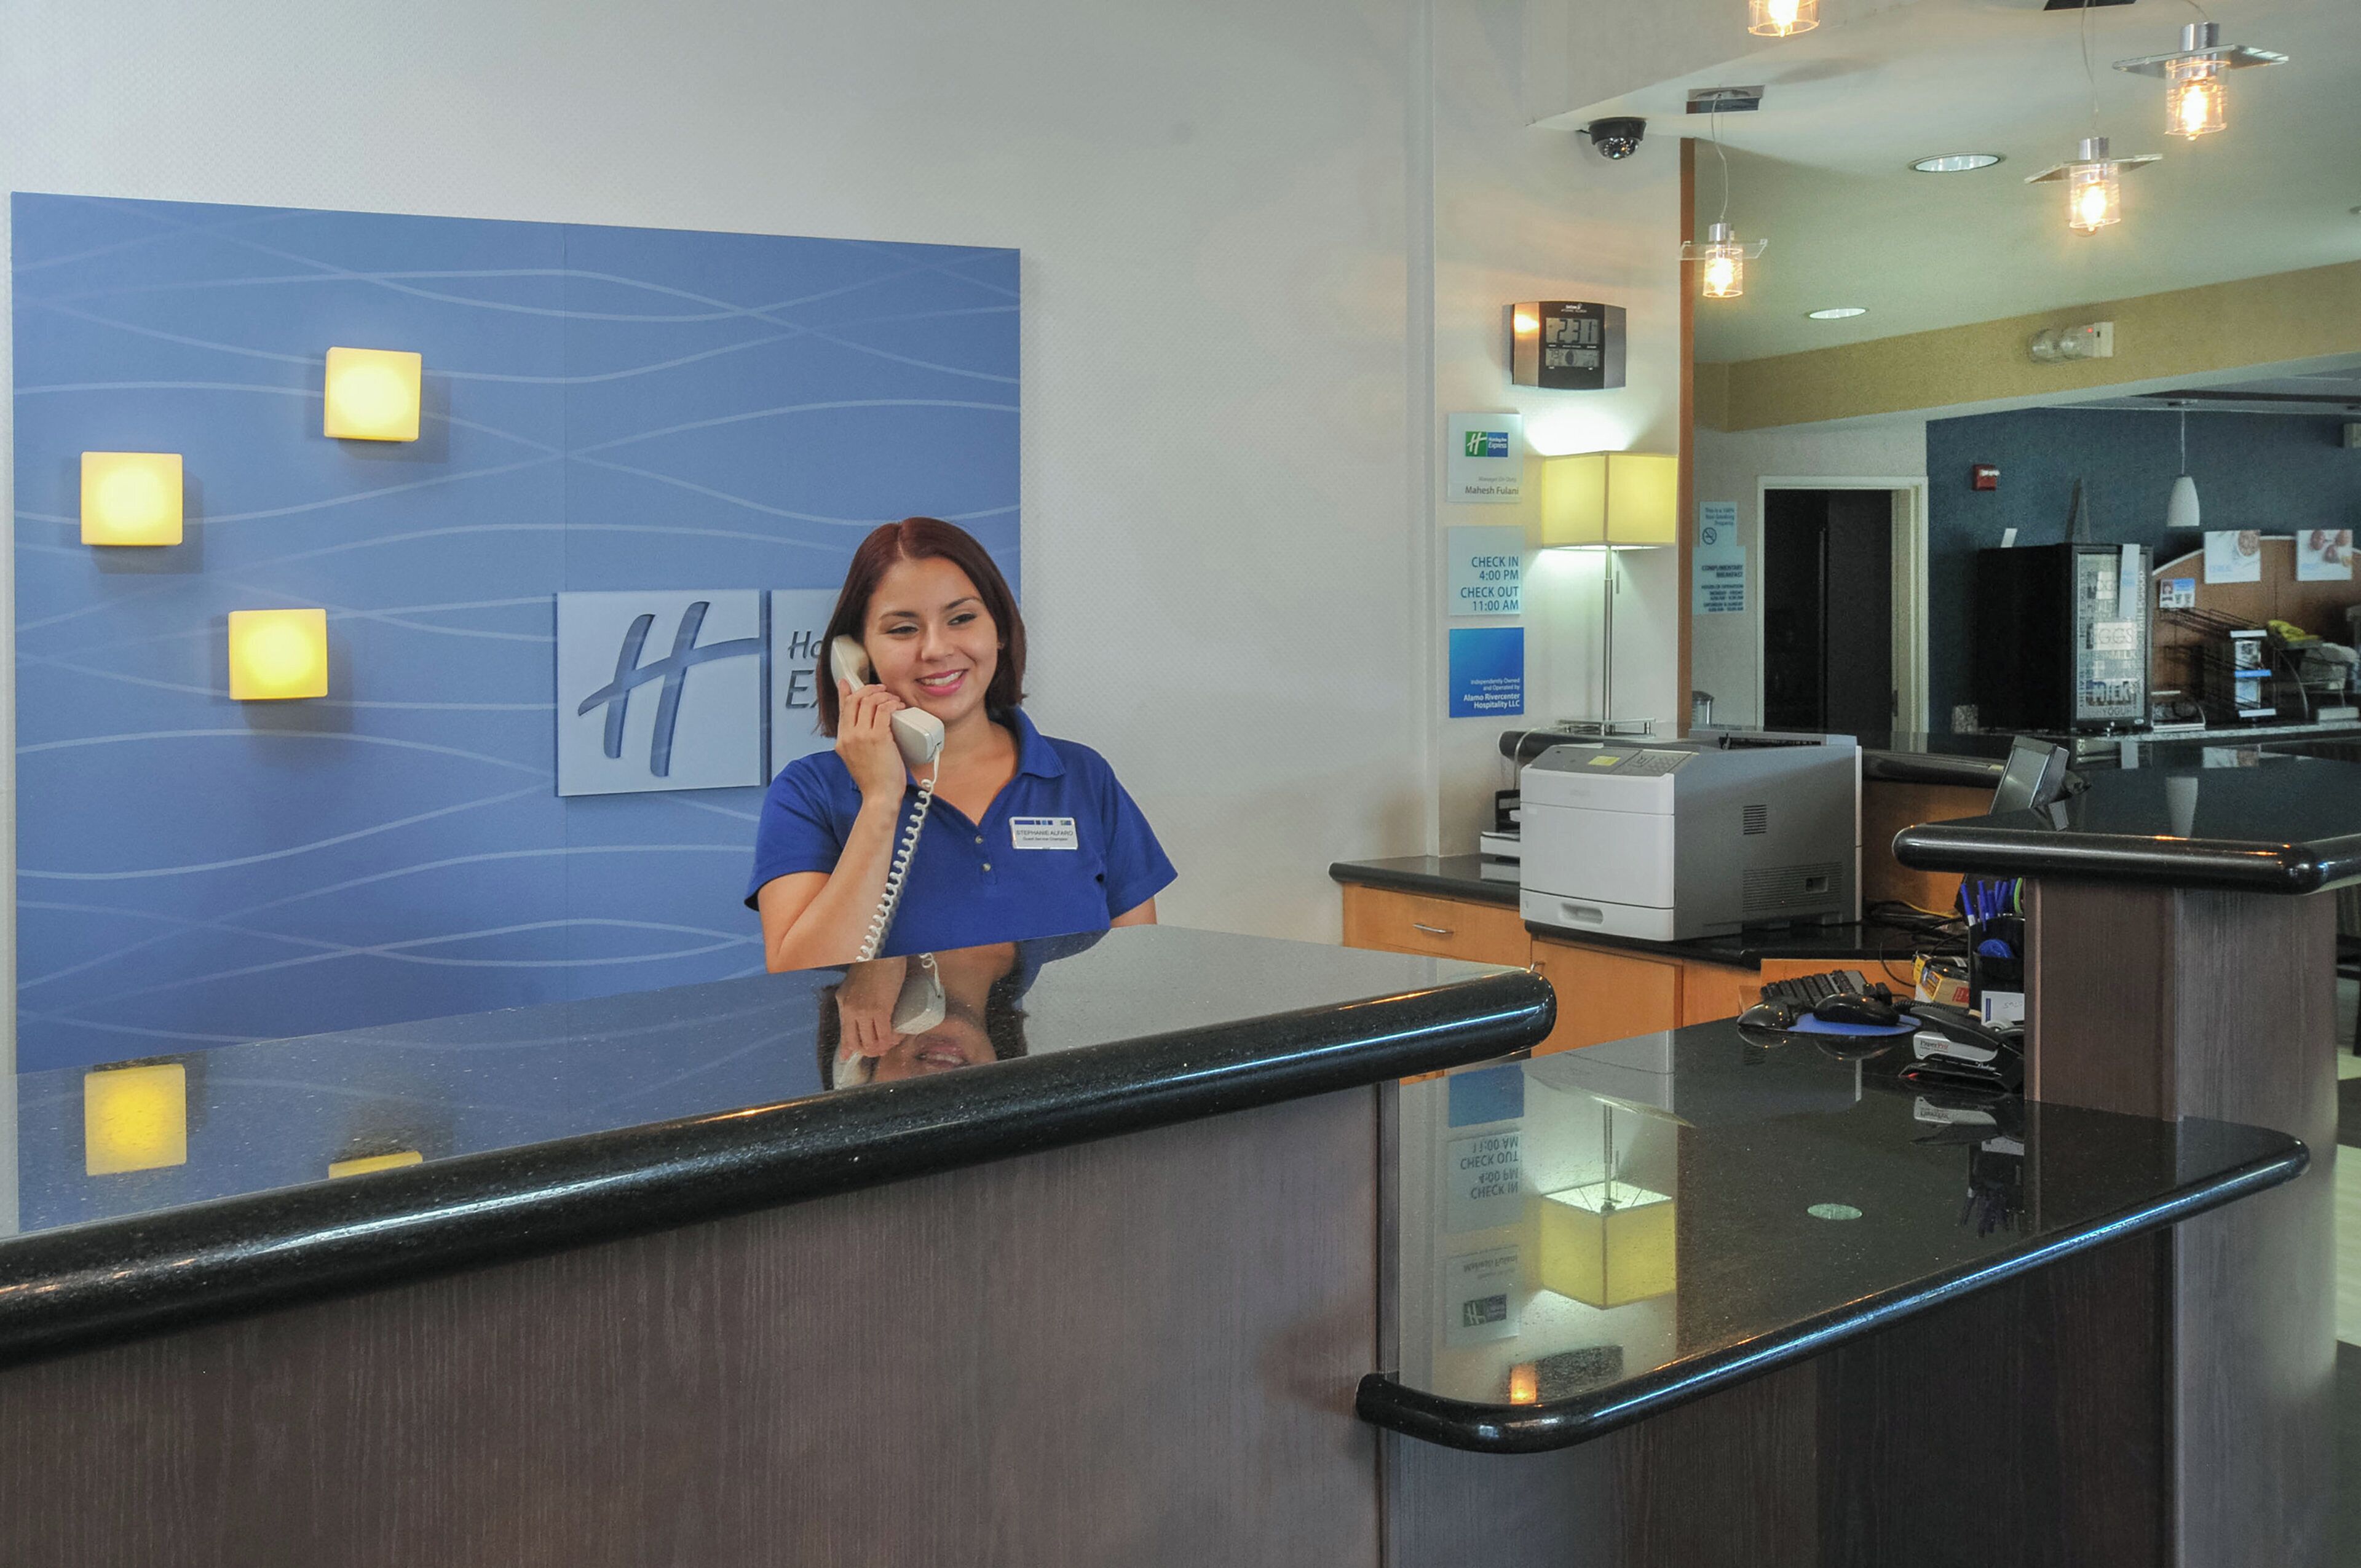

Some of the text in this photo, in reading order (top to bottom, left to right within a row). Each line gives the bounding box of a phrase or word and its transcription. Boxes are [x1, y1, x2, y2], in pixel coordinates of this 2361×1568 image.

[1465, 486, 1519, 495] Mahesh Fulani
[1471, 556, 1519, 568] CHECK IN
[1479, 569, 1519, 580] 4:00 PM
[1460, 586, 1519, 598] CHECK OUT
[1473, 600, 1519, 611] 11:00 AM
[1474, 701, 1508, 710] Hospitality
